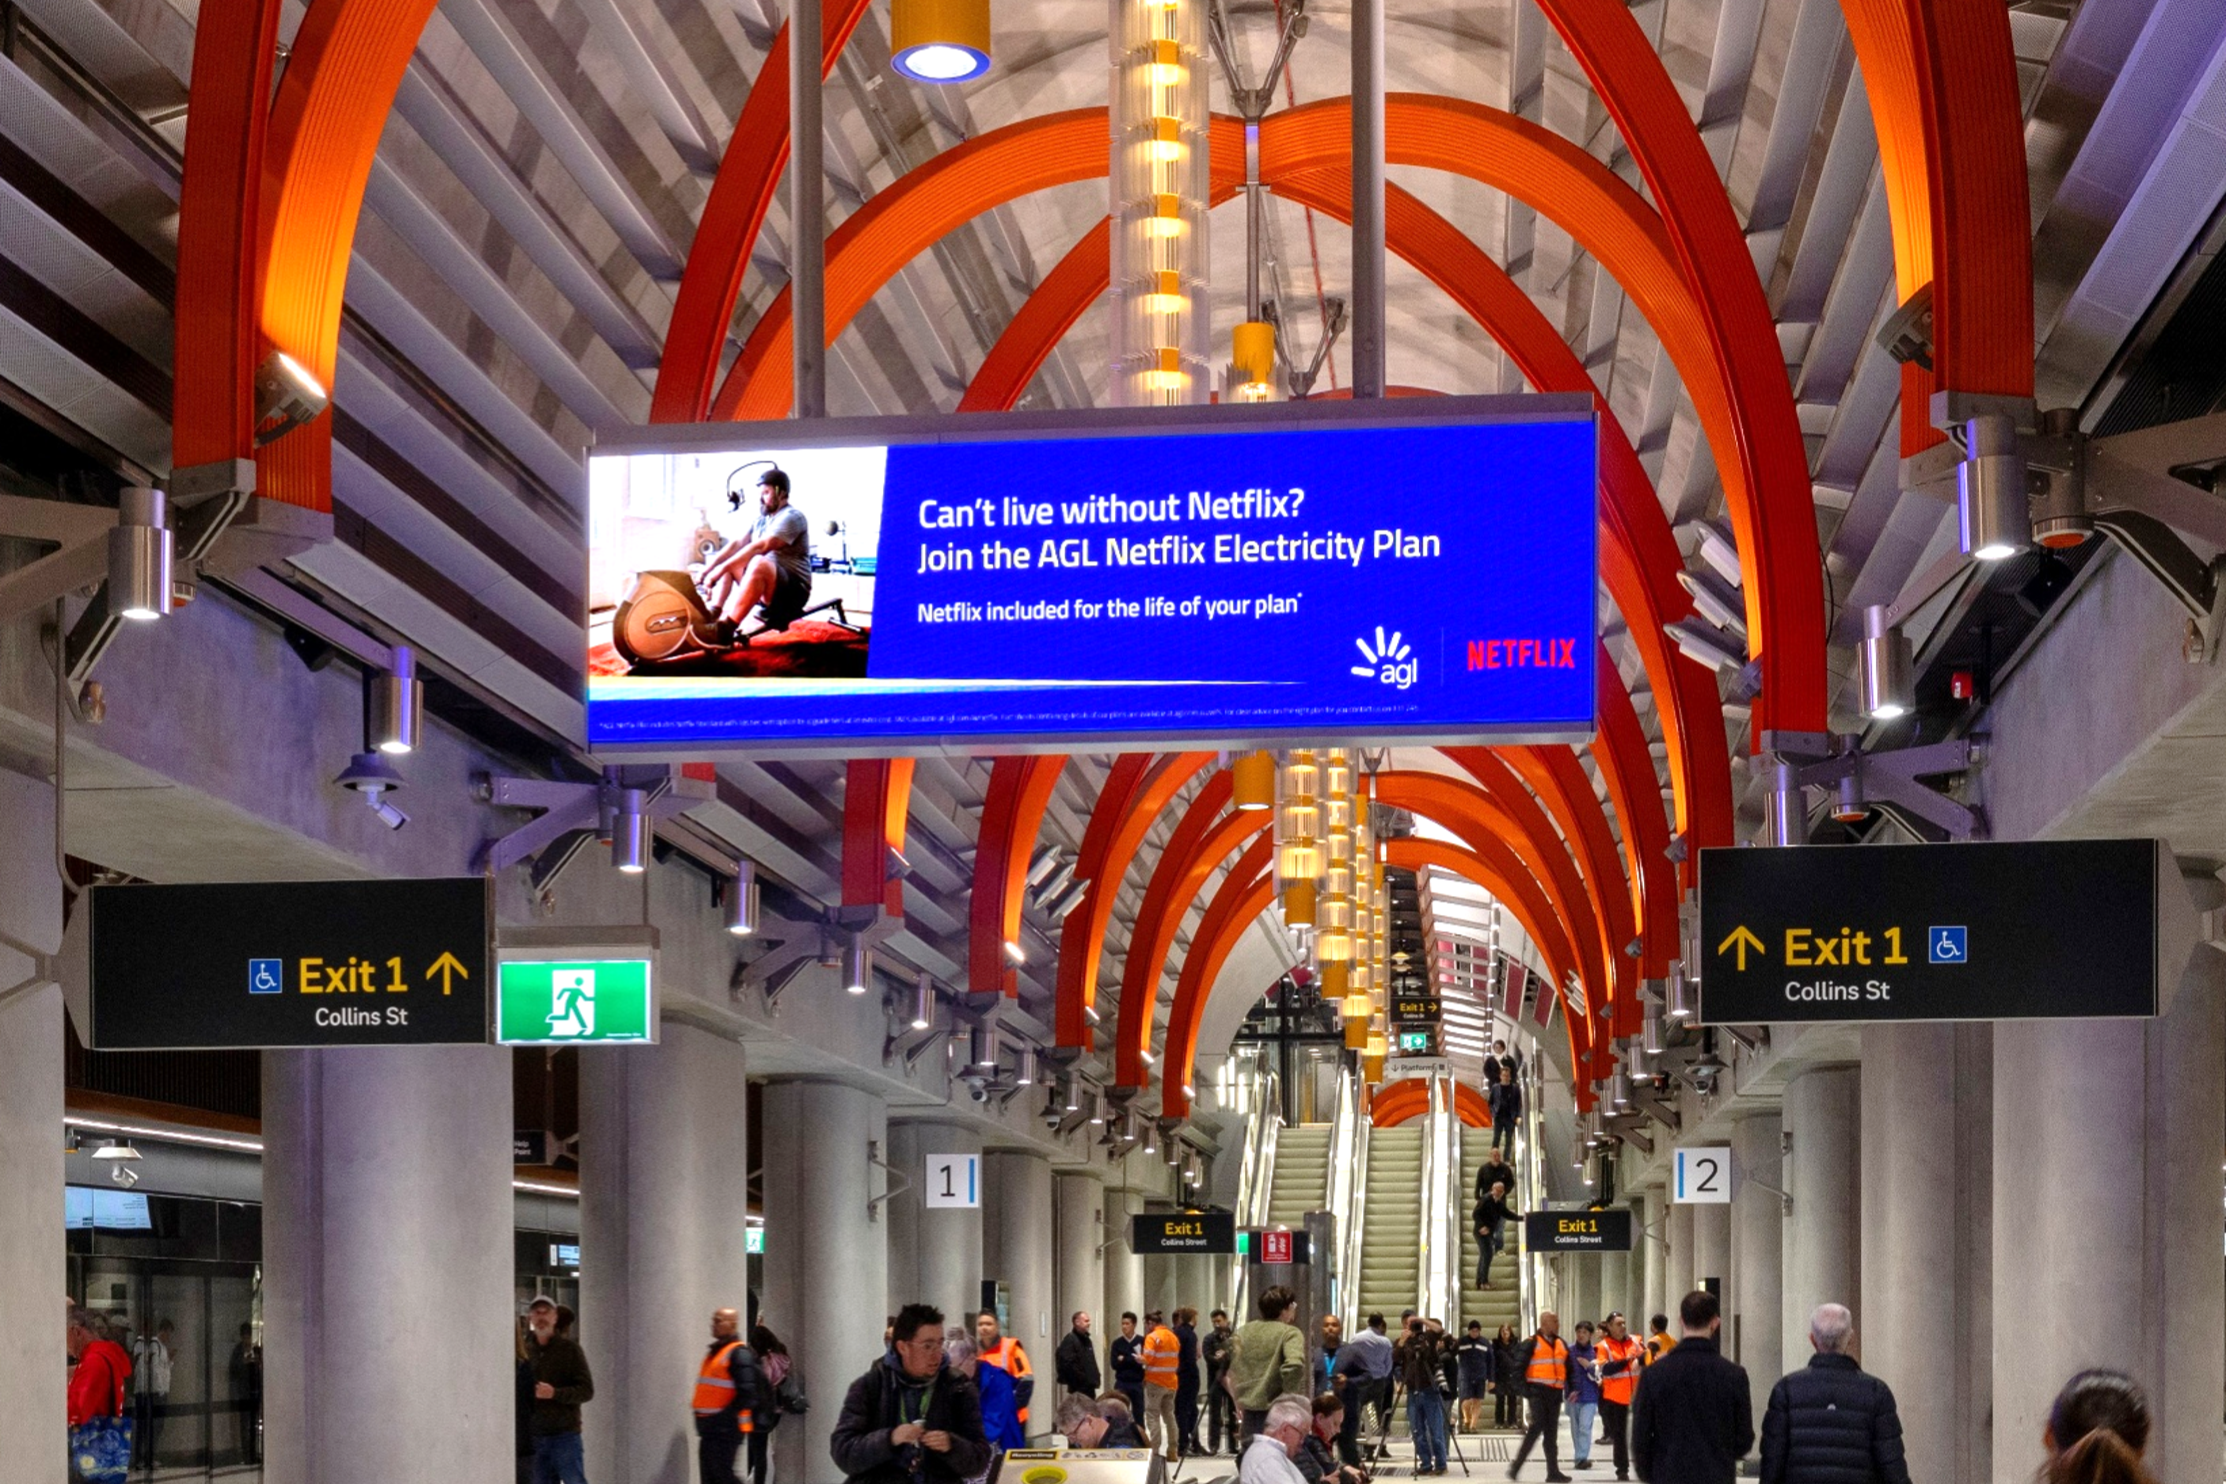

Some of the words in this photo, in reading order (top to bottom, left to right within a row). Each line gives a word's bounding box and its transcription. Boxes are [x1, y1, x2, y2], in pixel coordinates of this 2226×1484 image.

[919, 498, 996, 528] Can't
[1003, 497, 1054, 526] live
[1061, 494, 1180, 524] without
[1188, 488, 1305, 520] Netflix?
[917, 543, 973, 574] Join
[981, 541, 1030, 569] the
[1038, 538, 1098, 568] AGL
[1106, 535, 1206, 566] Netflix
[1214, 531, 1365, 567] Electricity
[1373, 528, 1440, 558] Plan
[918, 602, 982, 622] Netflix
[986, 600, 1069, 621] included
[1074, 599, 1102, 618] for
[1107, 597, 1140, 618] the
[1144, 597, 1175, 617] life
[1180, 596, 1201, 616] of
[1205, 598, 1250, 620] your
[1467, 638, 1576, 671] NETFLIX
[1380, 657, 1418, 690] agl
[1785, 927, 1872, 966] Exit
[1883, 926, 1908, 965] 1
[299, 955, 375, 994] Exit
[386, 956, 408, 993] 1
[1785, 980, 1860, 1001] Collins
[1865, 980, 1890, 1001] St
[315, 1006, 381, 1027] Collins
[386, 1006, 408, 1026] St
[1400, 1003, 1417, 1012] Exit
[1420, 1003, 1425, 1012] 1
[940, 1164, 956, 1197] 1
[1696, 1158, 1718, 1193] 2
[1164, 1221, 1192, 1235] Exit
[1195, 1222, 1203, 1235] 1
[1554, 1235, 1578, 1243] Collins
[1580, 1235, 1602, 1243] Street
[1558, 1219, 1586, 1233] Exit
[1589, 1220, 1598, 1233] 1
[1161, 1238, 1184, 1246] Collins
[1185, 1238, 1207, 1246] Street
